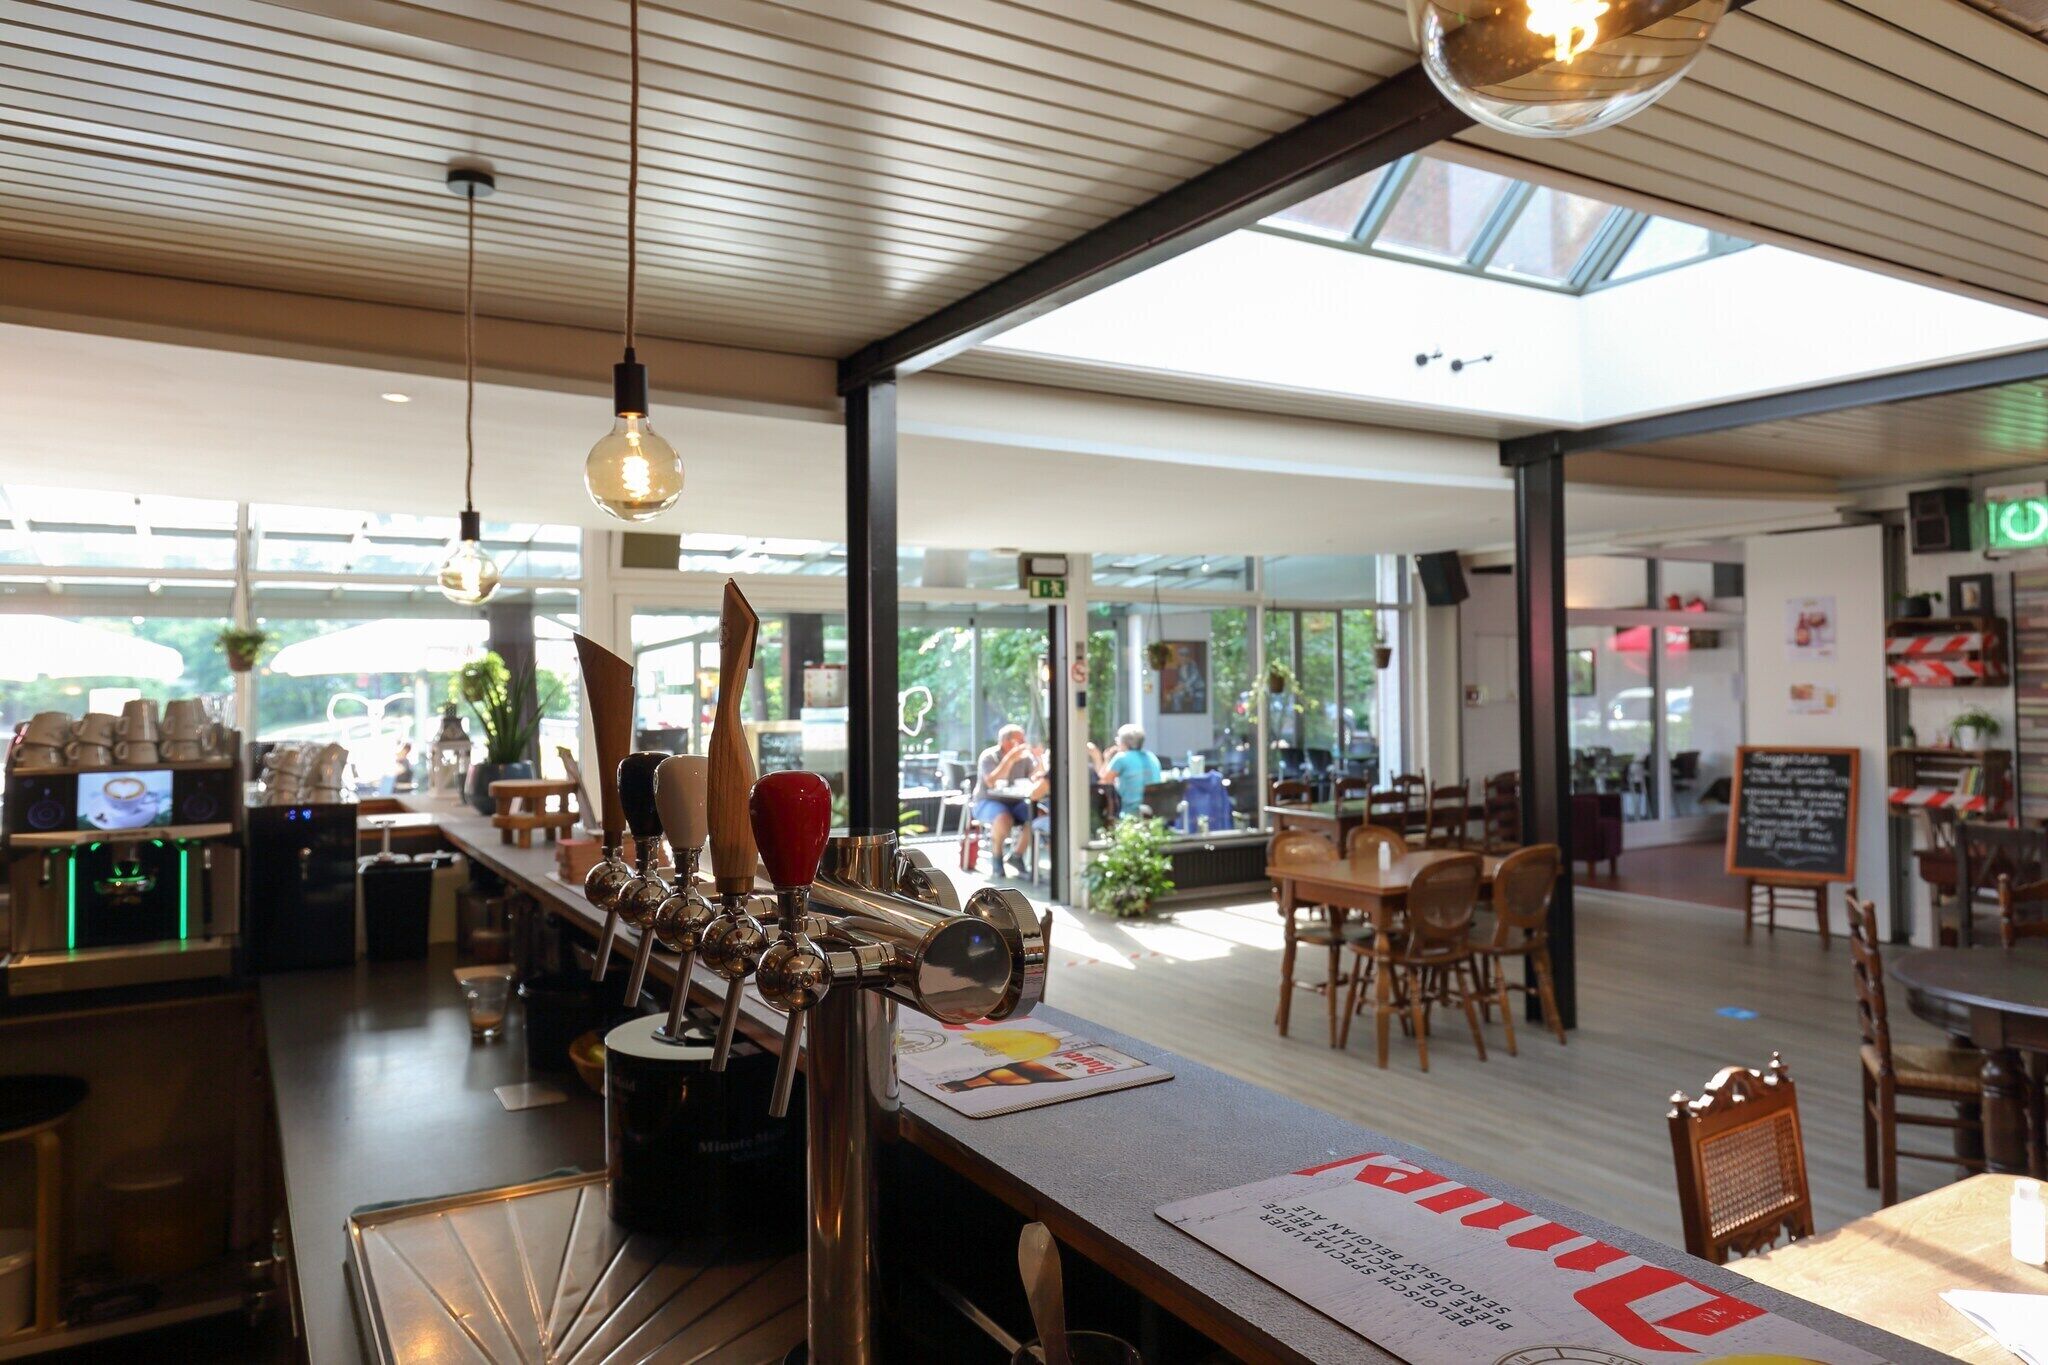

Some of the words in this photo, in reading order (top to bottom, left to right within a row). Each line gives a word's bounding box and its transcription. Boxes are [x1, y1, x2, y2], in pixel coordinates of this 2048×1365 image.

[1261, 1203, 1313, 1227] BELGE
[1291, 1205, 1328, 1221] ALE
[1258, 1213, 1377, 1275] SPECIAALBIER
[1324, 1222, 1405, 1259] BELGIAN
[1375, 1276, 1477, 1326] BELGISCH
[1403, 1261, 1512, 1314] SERIOUSLY
[1416, 1282, 1448, 1297] DE
